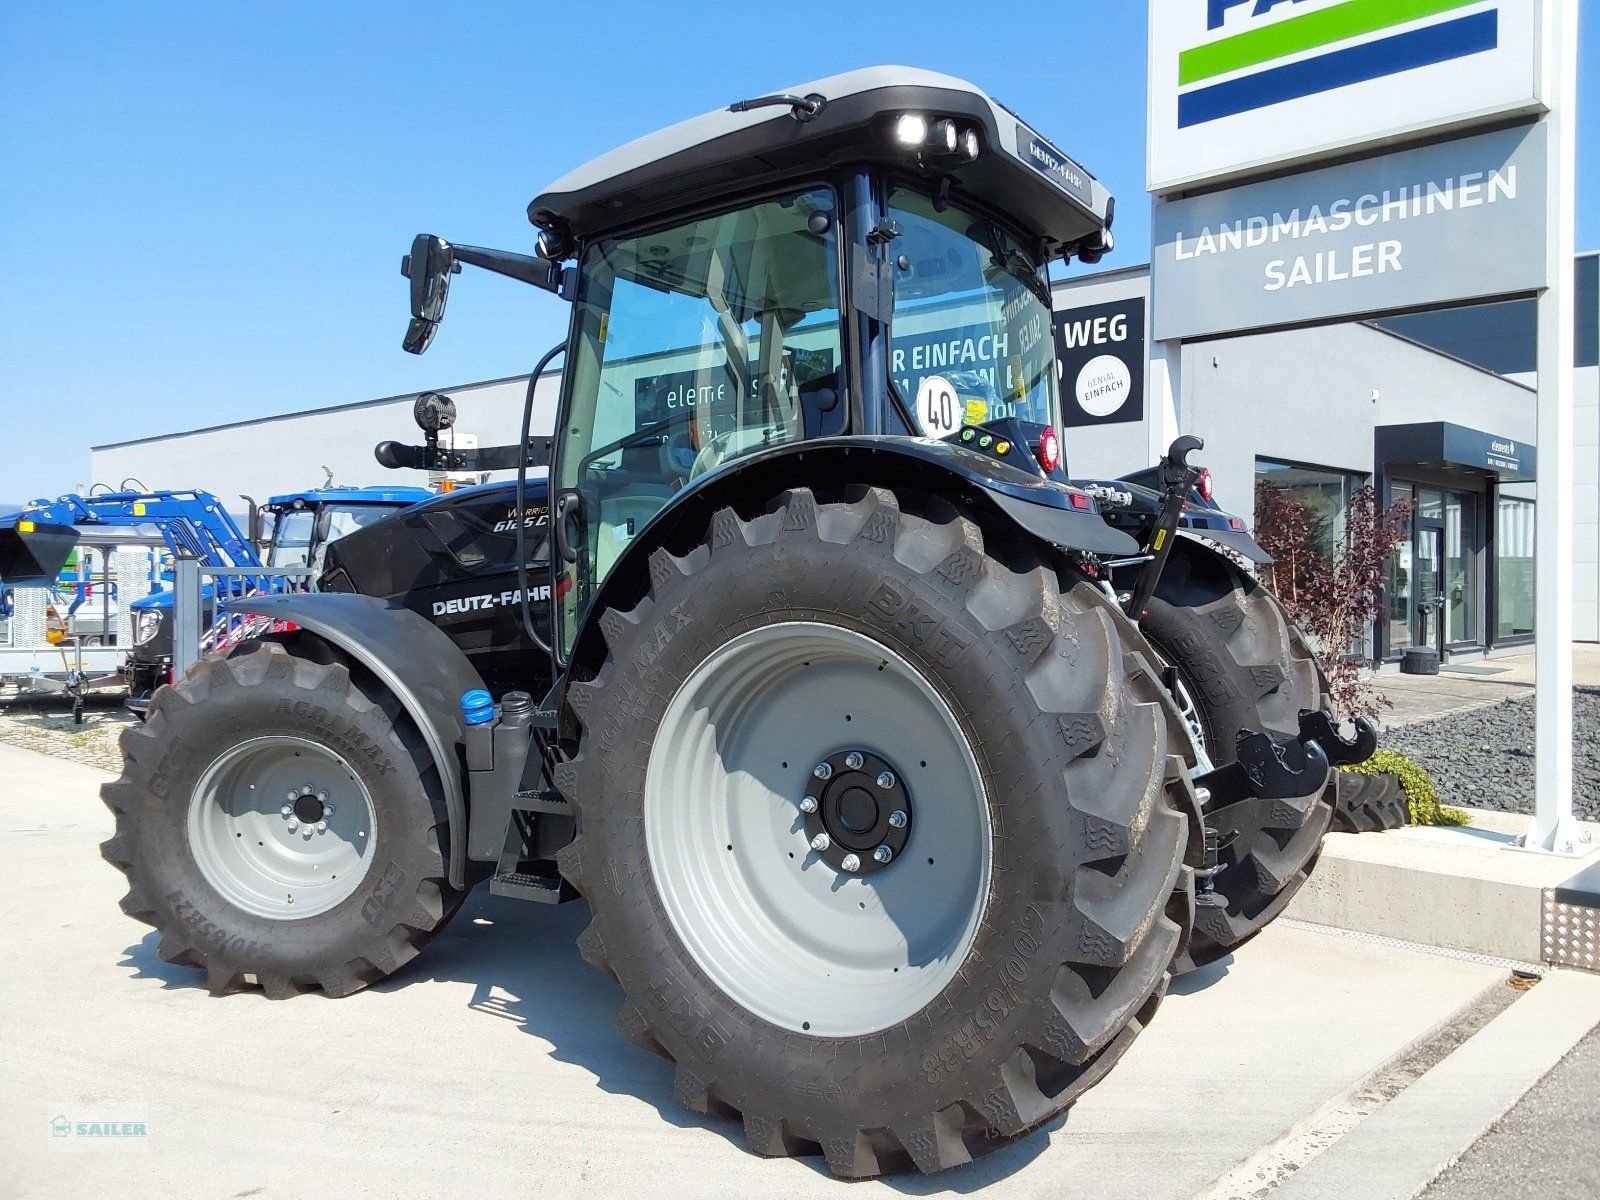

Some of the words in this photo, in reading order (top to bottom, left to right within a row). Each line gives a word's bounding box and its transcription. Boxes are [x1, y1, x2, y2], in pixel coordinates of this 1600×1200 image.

[1029, 142, 1082, 189] DEUTZ-FAHR
[1174, 165, 1518, 261] LANDMASCHINEN
[1263, 240, 1403, 291] SAILER
[1064, 313, 1127, 349] WEG
[1084, 380, 1124, 401] EINFACH
[1087, 372, 1116, 389] GENIAL
[927, 388, 953, 431] 40
[432, 585, 551, 616] DEUTZ-FAHR
[873, 582, 971, 669] BKT
